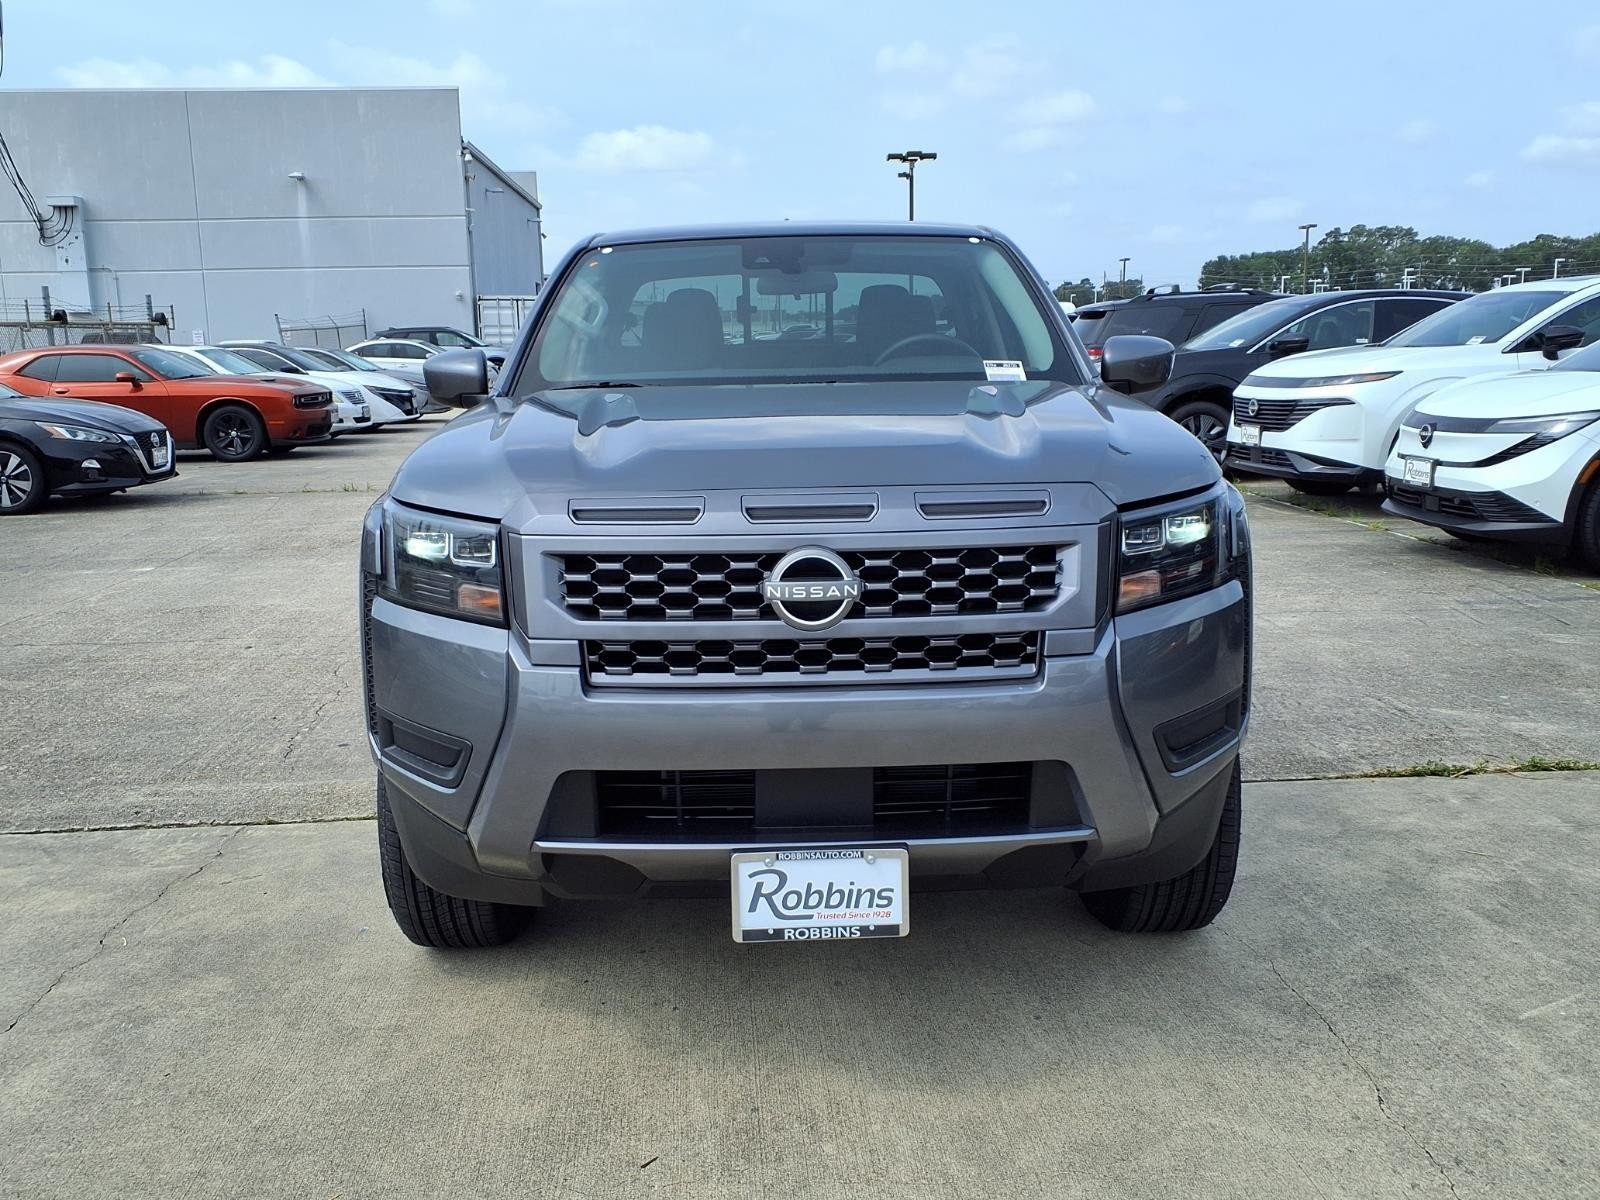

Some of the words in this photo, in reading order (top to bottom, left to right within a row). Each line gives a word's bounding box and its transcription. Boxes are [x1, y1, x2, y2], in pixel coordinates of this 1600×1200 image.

[767, 584, 858, 598] NISSAN
[778, 851, 861, 860] ROBBINSAUTO.COM
[747, 868, 895, 921] Robbins
[816, 911, 847, 920] Trusted
[848, 911, 871, 919] Since
[872, 910, 892, 918] 1928
[784, 926, 861, 940] ROBBINS
